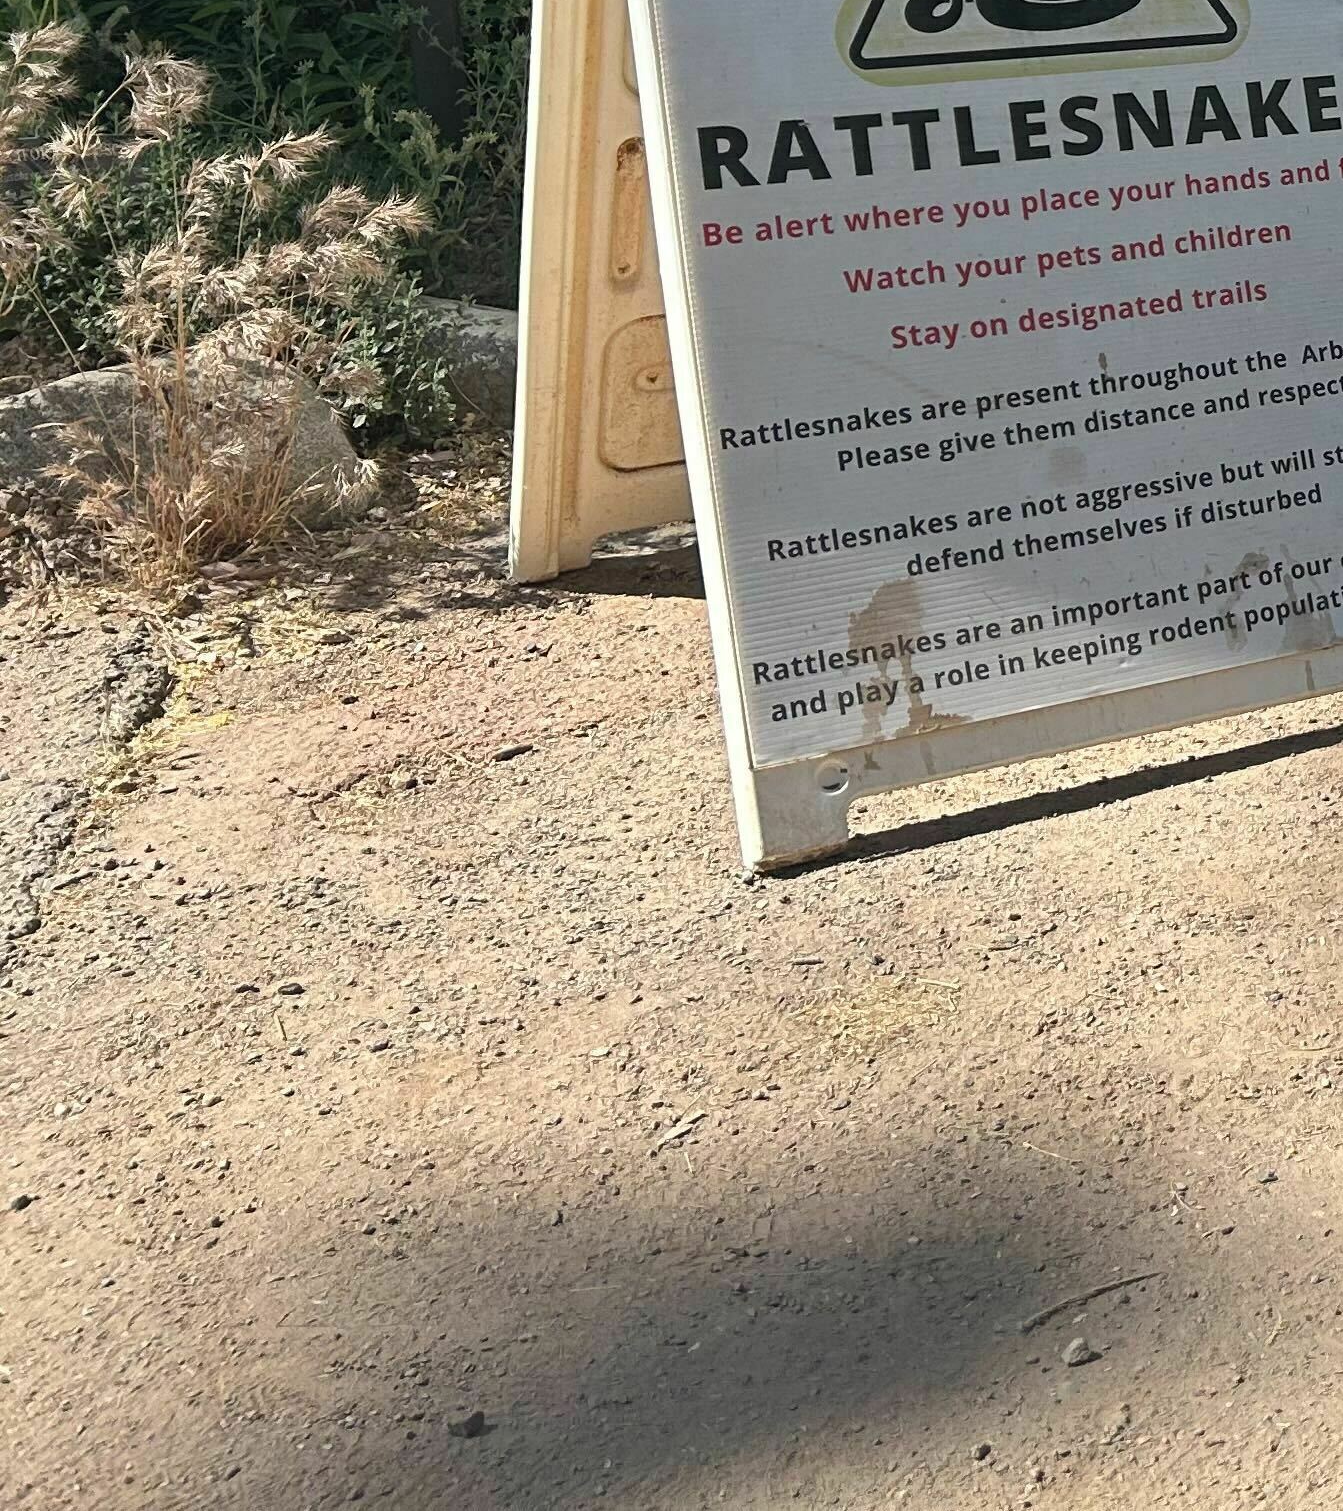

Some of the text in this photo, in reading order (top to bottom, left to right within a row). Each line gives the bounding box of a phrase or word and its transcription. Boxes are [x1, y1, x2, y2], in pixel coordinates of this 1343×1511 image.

[703, 222, 743, 246] Be
[755, 213, 834, 242] alert
[845, 205, 944, 232] where
[953, 198, 1010, 227] you
[1021, 189, 1100, 220] place
[1109, 180, 1175, 210] your
[1185, 167, 1271, 196] hands
[1280, 159, 1330, 186] and
[843, 223, 1292, 293] Watch your pets and children
[891, 280, 1268, 349] Stay on designated trails
[719, 406, 912, 450] Rattlesnakes
[921, 399, 967, 421] are
[976, 379, 1081, 419] present
[1088, 357, 1238, 397] throughout
[1245, 350, 1287, 373] the
[837, 442, 930, 472] Please
[939, 432, 996, 462] give
[1003, 420, 1076, 447] them
[1084, 401, 1195, 434] distance
[1203, 389, 1250, 415] and
[767, 514, 958, 561] Rattlesnakes
[967, 505, 1012, 528] are
[1021, 492, 1068, 519] not
[1076, 471, 1213, 513] aggressive
[1220, 461, 1264, 484] but
[1270, 448, 1315, 475] will
[907, 483, 1322, 576] defend themselves if disturbed
[752, 631, 946, 685] Rattlesnakes
[956, 622, 1001, 645] are
[1010, 612, 1044, 636] an
[1052, 583, 1189, 627] important
[1197, 571, 1251, 602] part
[1258, 561, 1283, 587] of
[1291, 555, 1333, 581] our
[771, 690, 827, 722] and
[837, 678, 899, 715] play
[909, 675, 926, 694] a
[934, 661, 990, 689] role
[998, 653, 1026, 676] in
[1033, 632, 1142, 669] keeping
[1149, 611, 1236, 646] rodent
